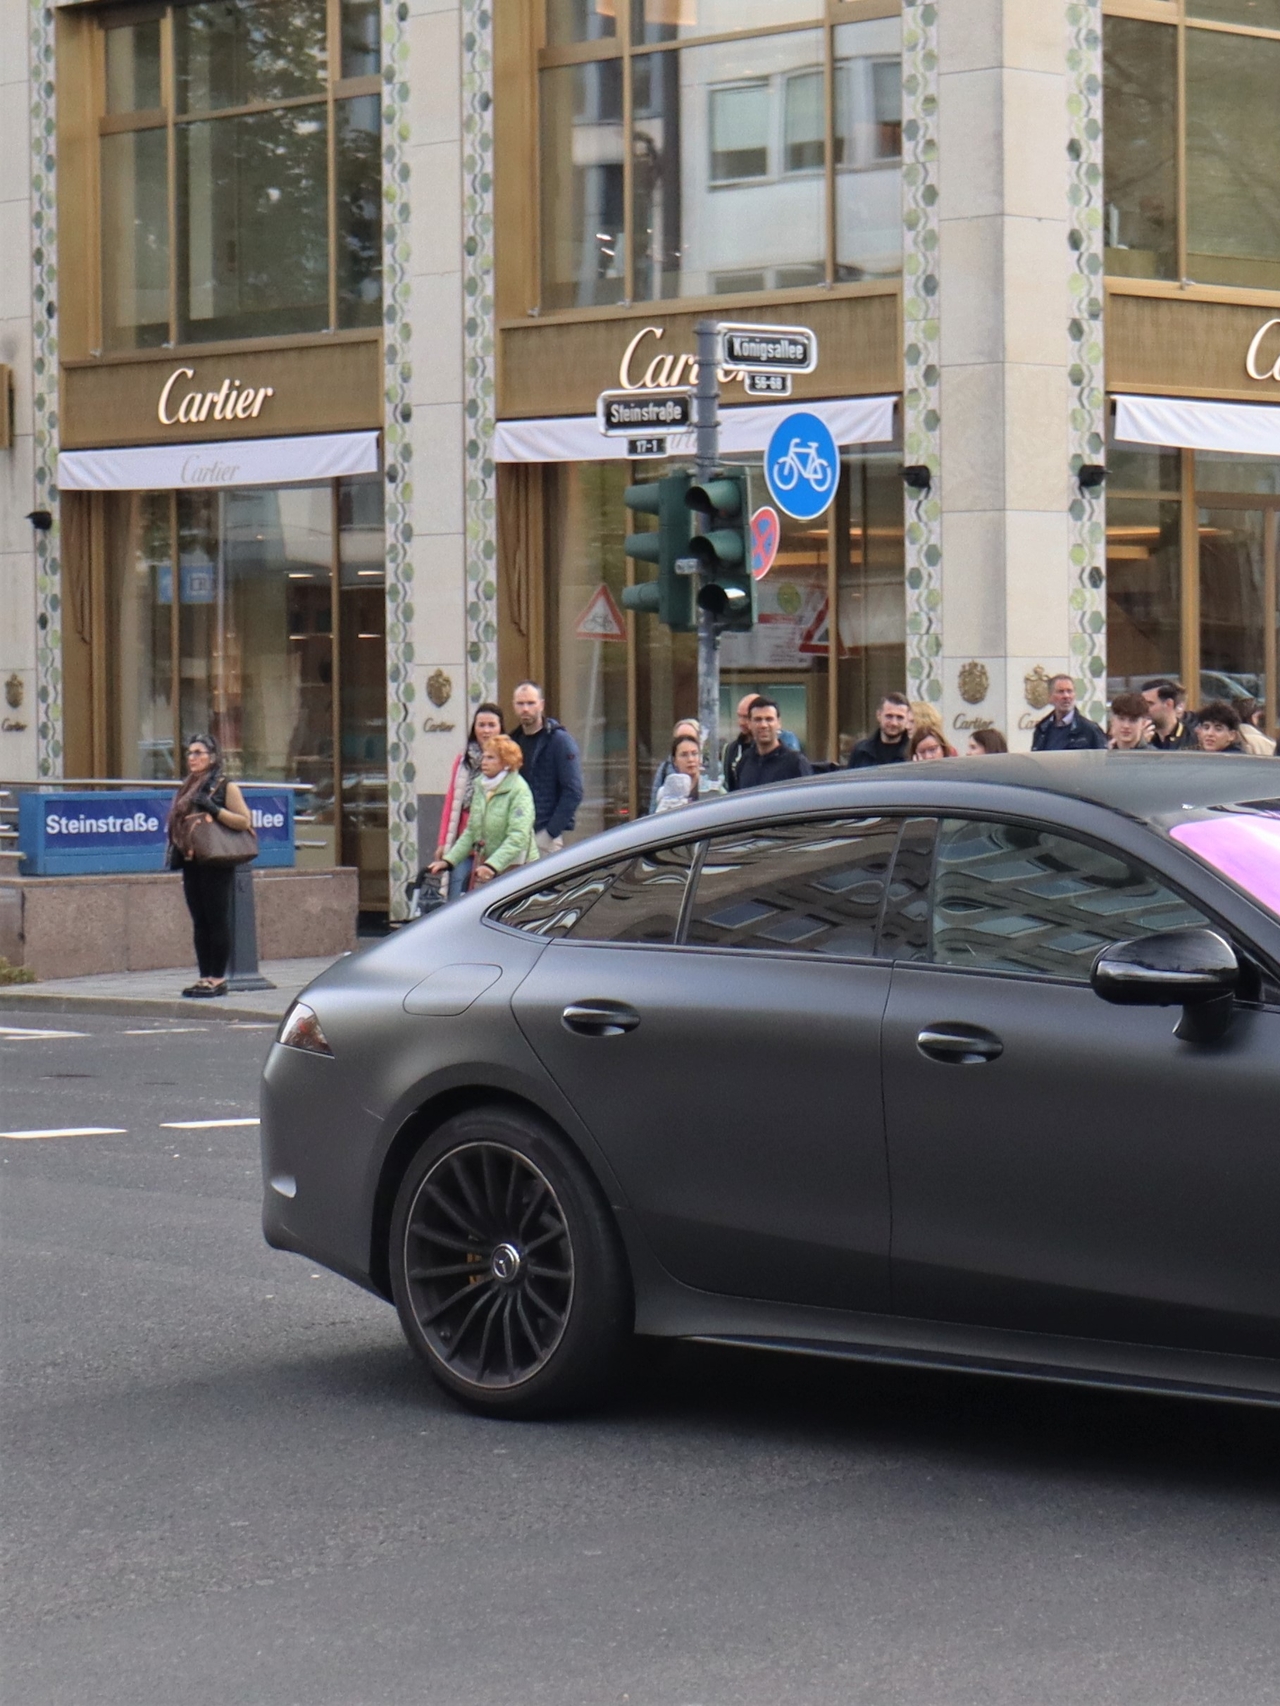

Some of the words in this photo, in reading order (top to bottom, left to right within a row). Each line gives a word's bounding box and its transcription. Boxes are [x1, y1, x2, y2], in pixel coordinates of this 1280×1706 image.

[732, 336, 804, 361] Königsallee
[158, 367, 274, 424] Cartier
[610, 402, 682, 423] Steinstraße
[636, 439, 658, 454] 17-1
[181, 455, 240, 483] Cartier
[953, 712, 994, 730] Cartier
[46, 813, 159, 835] Steinstraße
